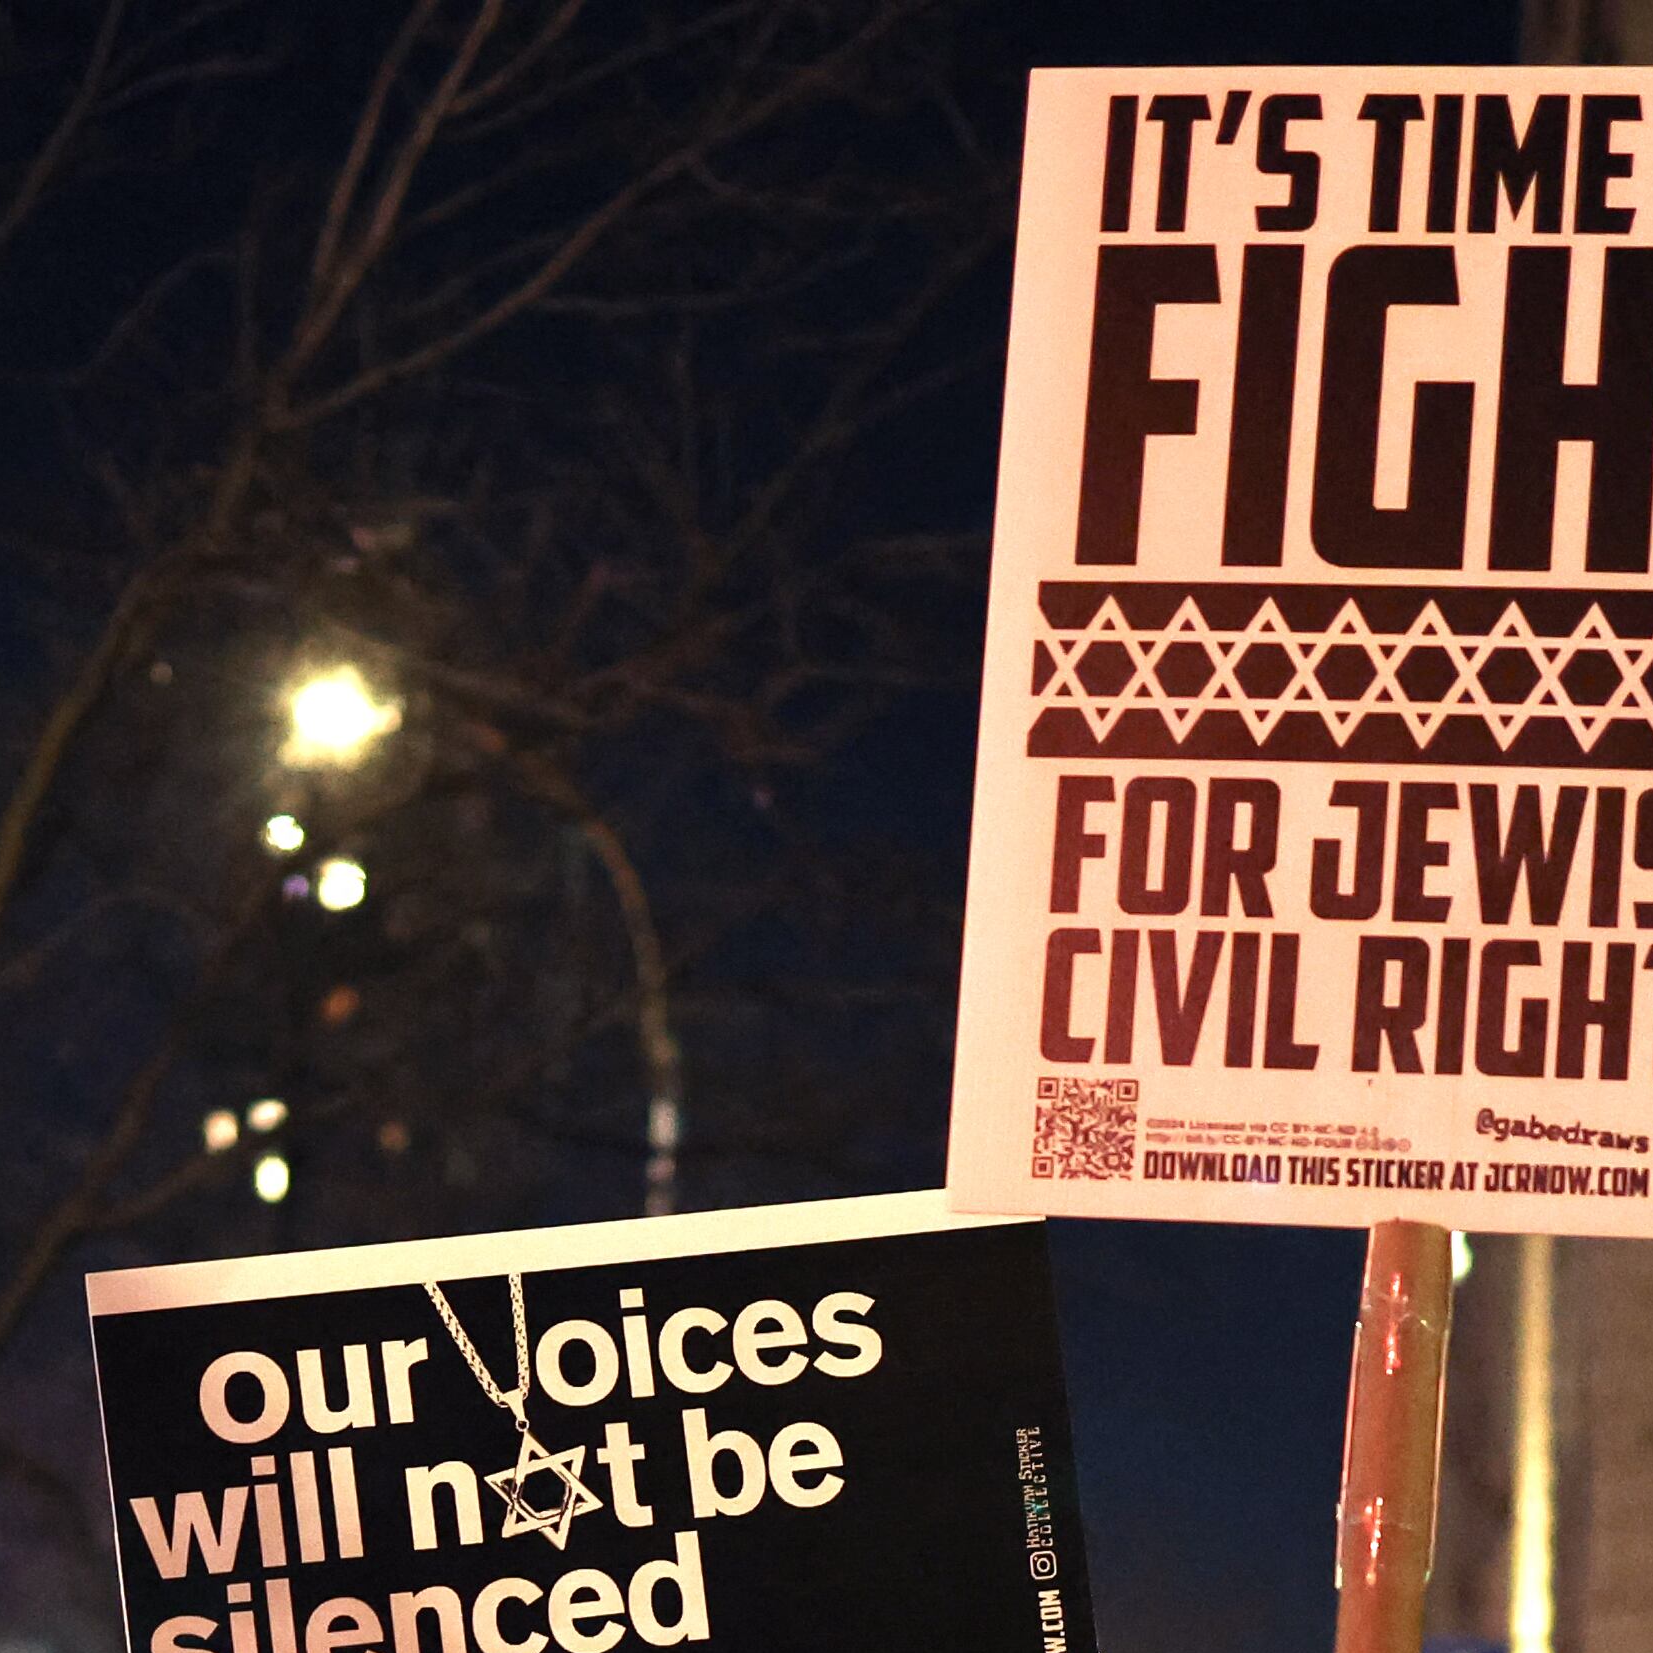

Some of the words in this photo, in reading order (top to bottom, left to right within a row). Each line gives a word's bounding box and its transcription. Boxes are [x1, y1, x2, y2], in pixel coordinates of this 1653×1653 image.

[1099, 90, 1323, 233] IT'S
[1357, 93, 1643, 235] TIME
[1049, 774, 1281, 919] FOR
[1039, 928, 1320, 1073] CIVIL
[1143, 1150, 1282, 1184] DOWNLOAD
[1287, 1155, 1340, 1187] THIS
[1345, 1157, 1445, 1190] STICKER
[1449, 1161, 1479, 1191] AT
[1483, 1161, 1650, 1198] JCRNOW.COM
[1475, 1107, 1650, 1153] @gabedraws
[198, 1336, 428, 1444] our
[130, 1446, 363, 1580] will
[681, 1407, 845, 1519] be
[1028, 1426, 1054, 1548] COLLECTIVE
